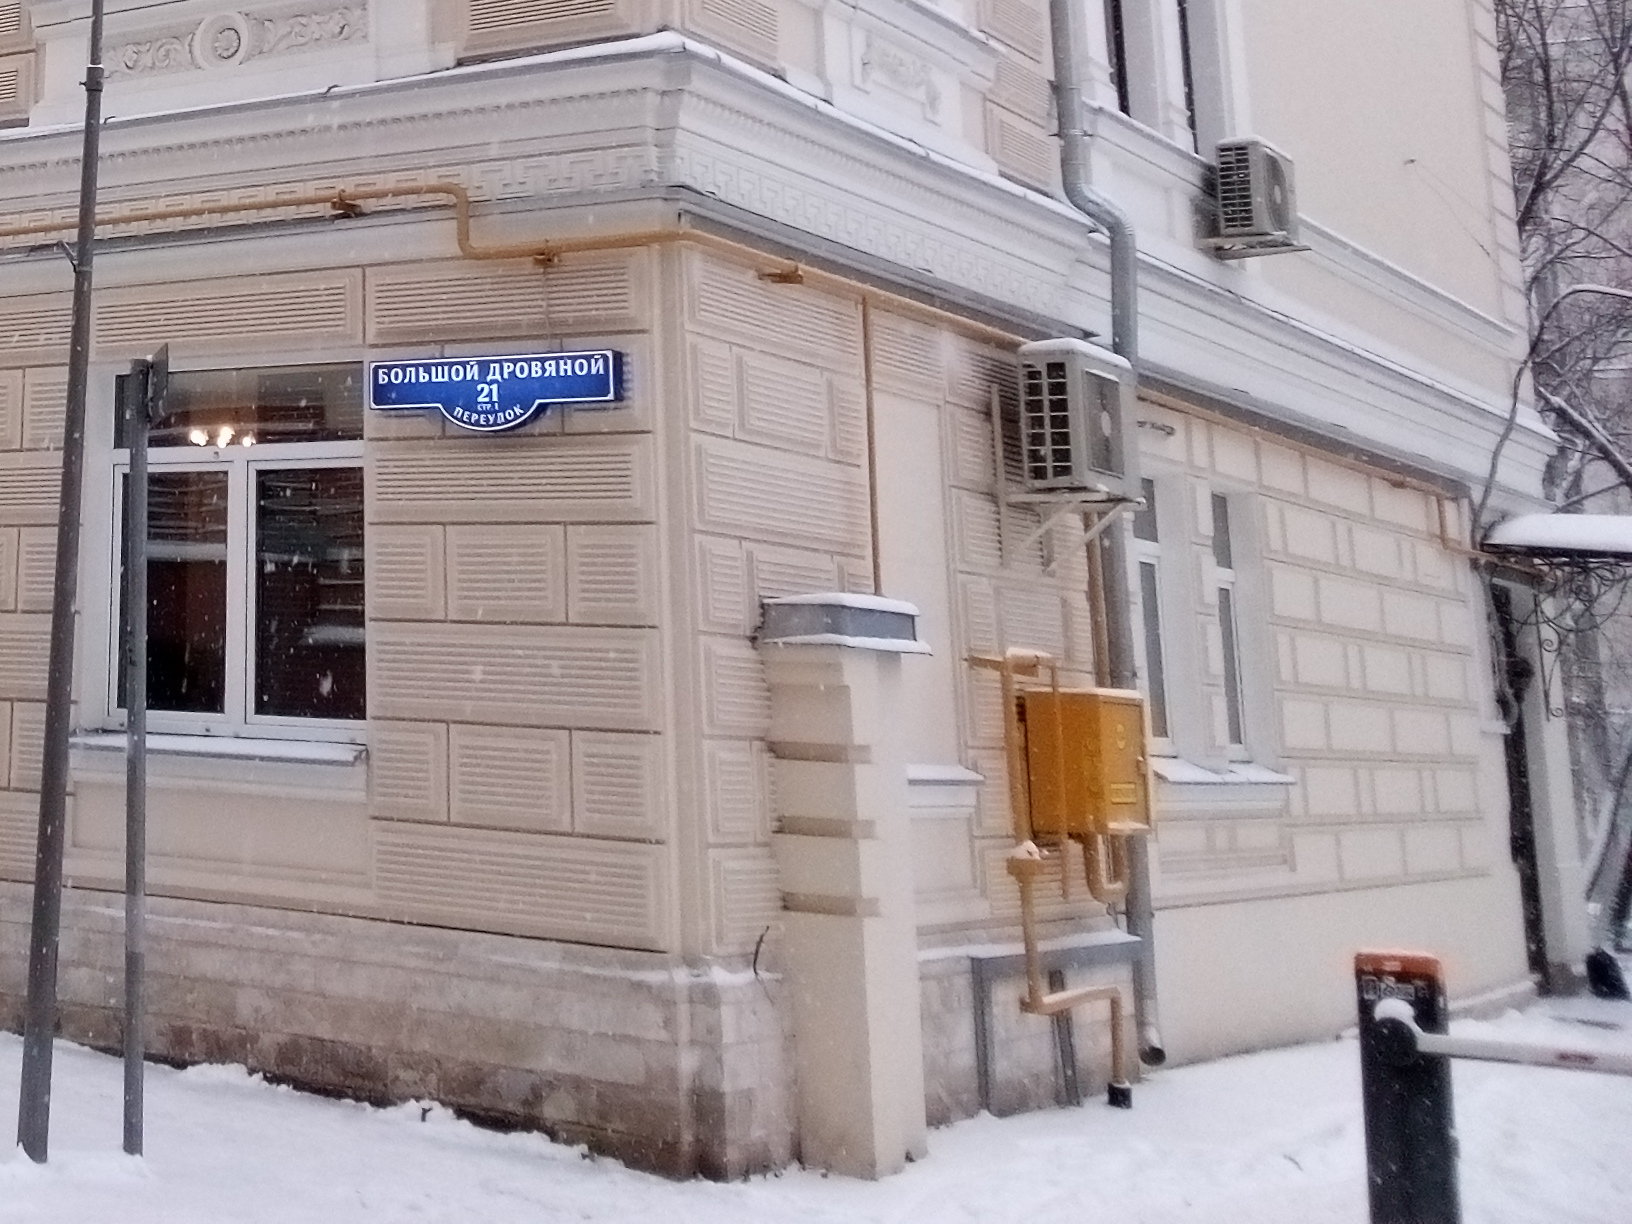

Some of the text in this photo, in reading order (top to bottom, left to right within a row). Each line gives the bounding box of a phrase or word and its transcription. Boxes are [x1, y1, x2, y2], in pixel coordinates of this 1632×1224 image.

[378, 354, 605, 385] БОЛЬШОЙ ДРОВЯНОЙ
[476, 383, 499, 403] 21
[453, 403, 525, 425] ПЕРЕУЛОК
